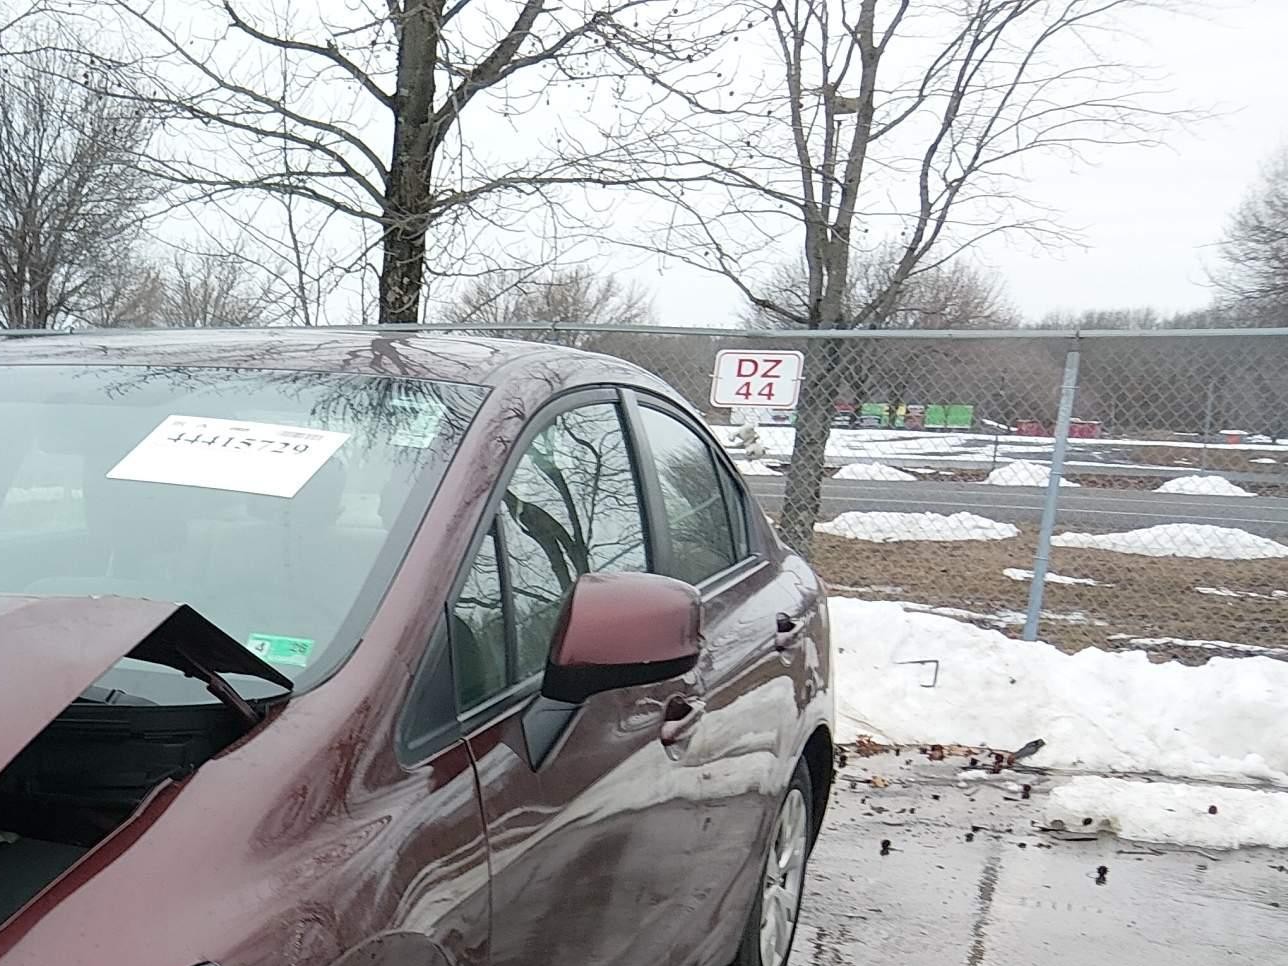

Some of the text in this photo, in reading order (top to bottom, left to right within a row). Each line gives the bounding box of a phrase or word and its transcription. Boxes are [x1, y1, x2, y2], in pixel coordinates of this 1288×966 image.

[736, 358, 783, 378] DZ
[734, 381, 775, 401] 44
[167, 432, 309, 454] 44415729
